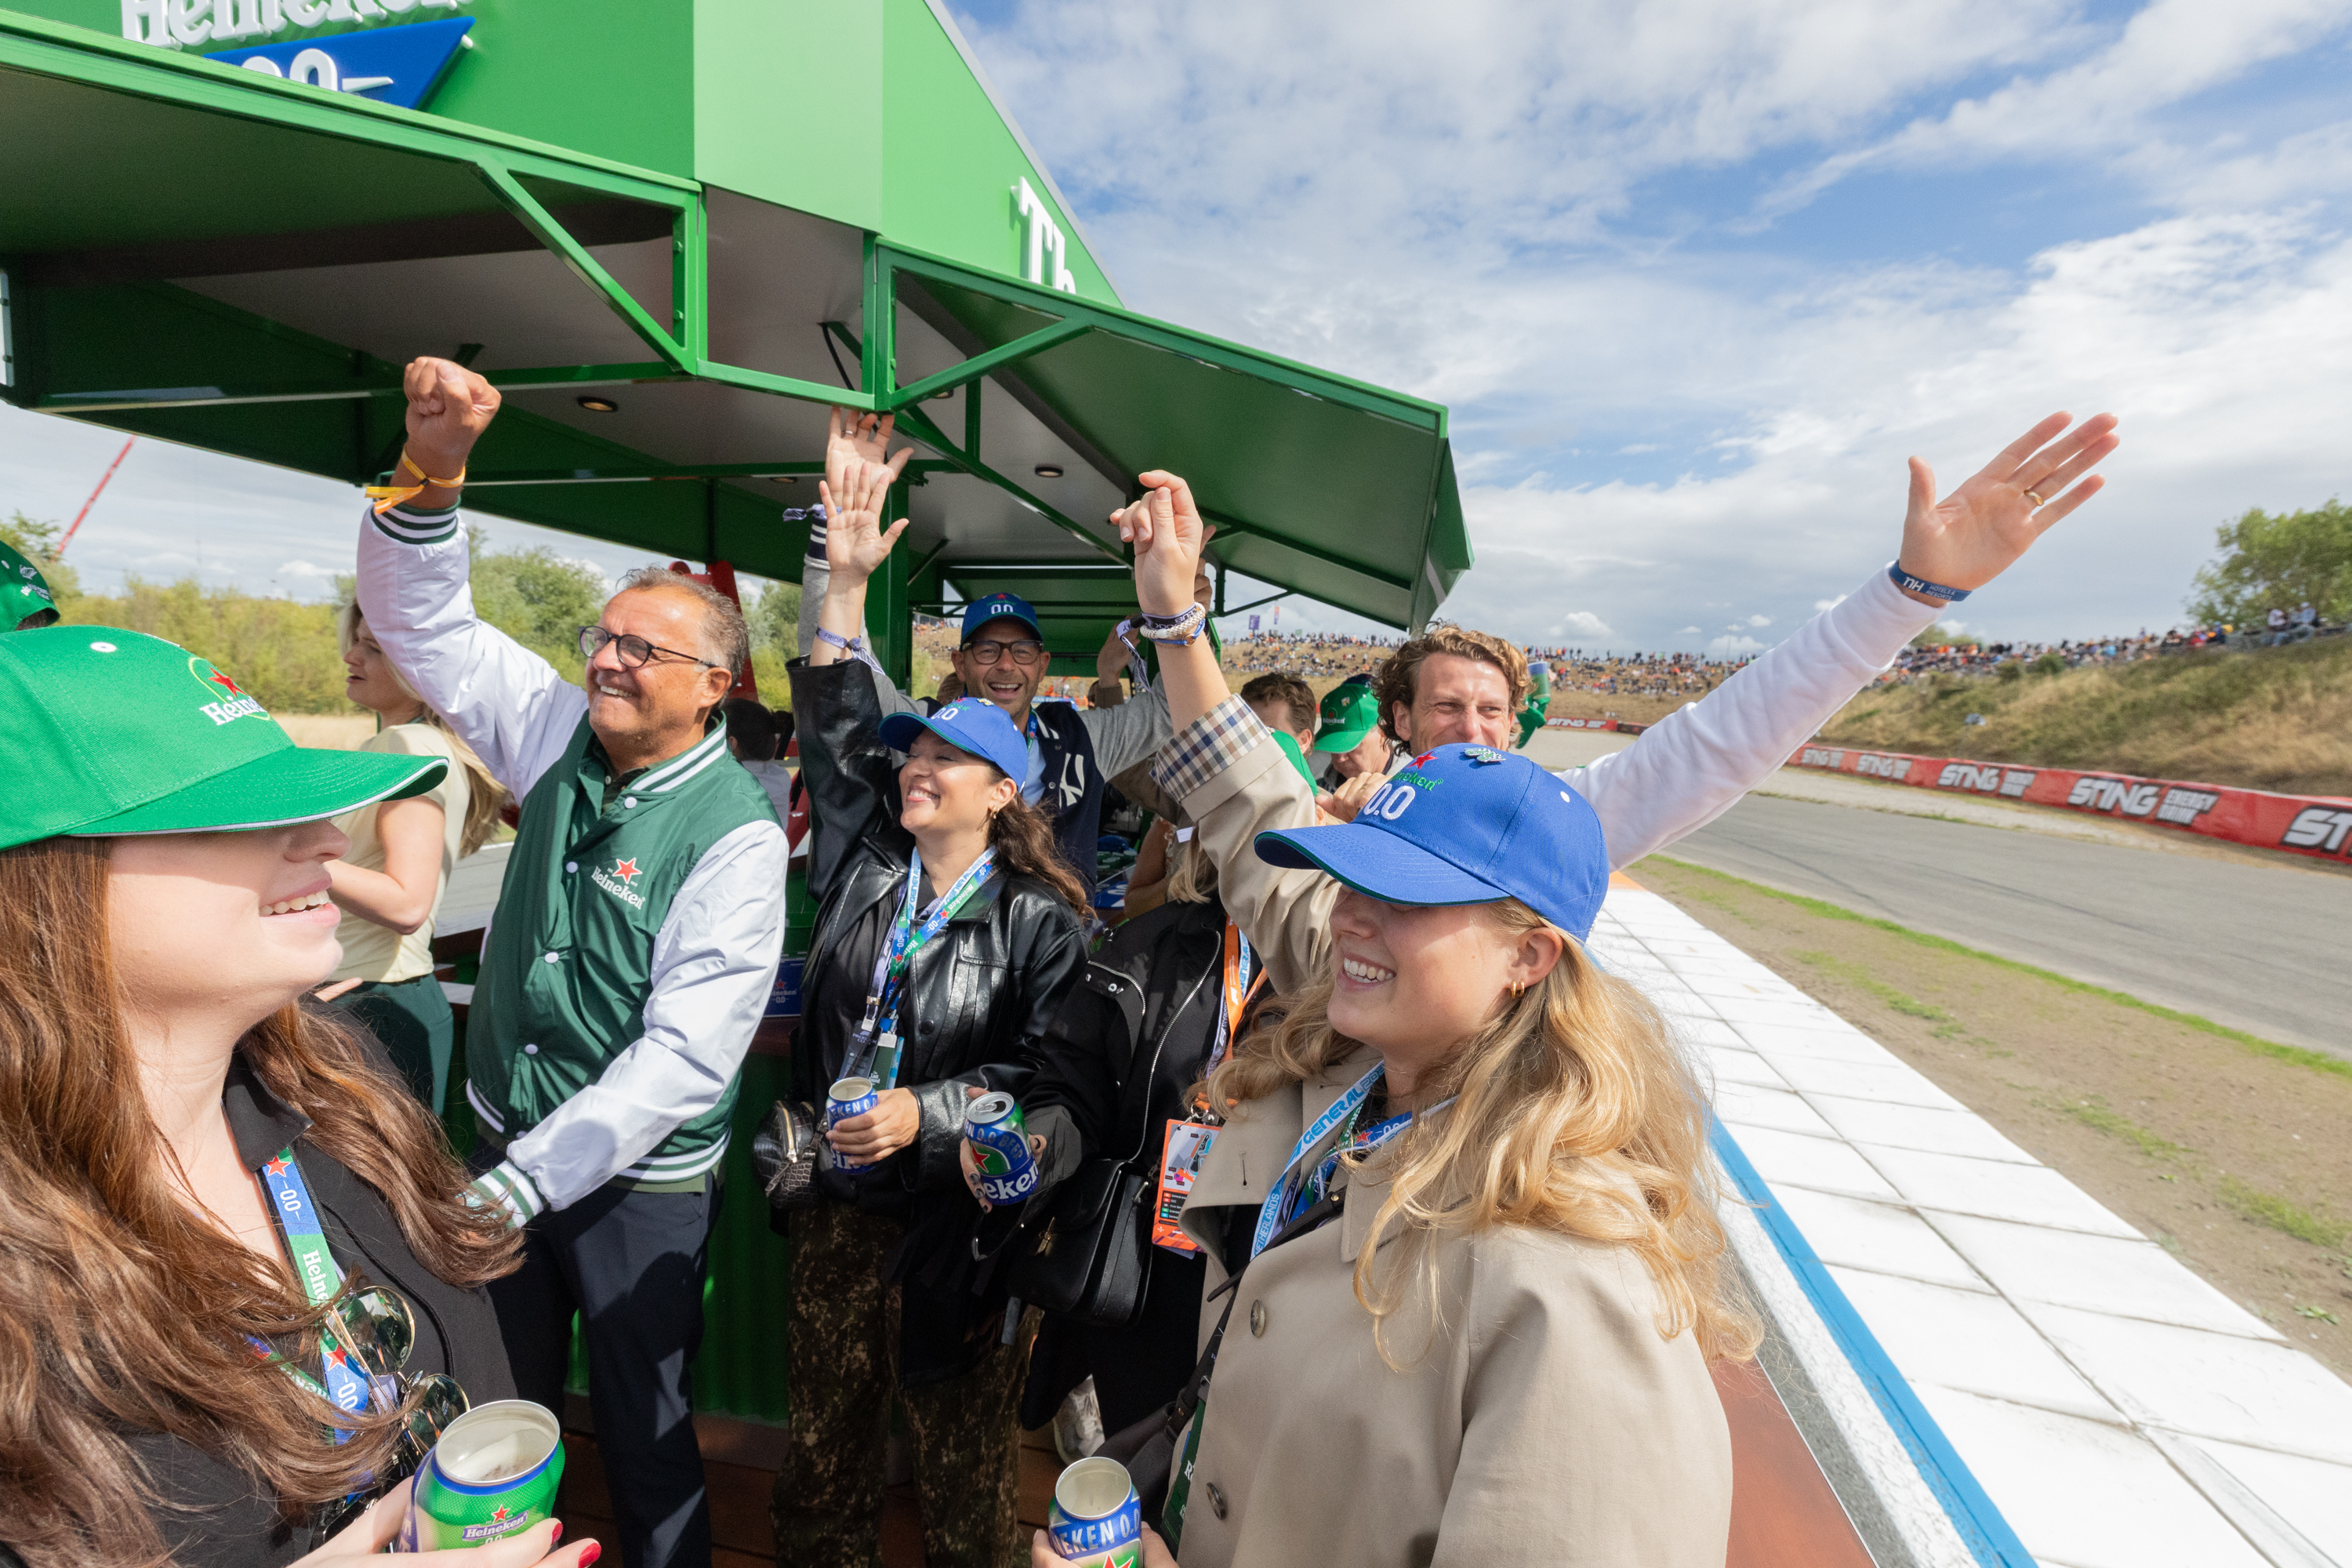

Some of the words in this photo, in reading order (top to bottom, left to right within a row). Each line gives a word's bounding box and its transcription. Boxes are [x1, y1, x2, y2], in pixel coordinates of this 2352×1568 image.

[122, 0, 457, 49] Heine
[1926, 590, 1953, 601] RESORTS
[1929, 585, 1951, 594] HOTELS
[1175, 608, 1196, 623] LUB
[199, 693, 267, 725] Hein
[1937, 764, 1999, 791] STING
[1363, 783, 1415, 820] 0.0
[2067, 778, 2161, 816] STING
[591, 866, 642, 909] Heineken
[948, 883, 975, 909] Heineken
[1303, 1087, 1365, 1145] GENERAL
[1359, 1063, 1385, 1091] 202
[983, 1161, 1039, 1200] eken
[1254, 1192, 1279, 1255] NETHERLANDS
[303, 1250, 329, 1303] Heine
[466, 1515, 524, 1538] Heineken
